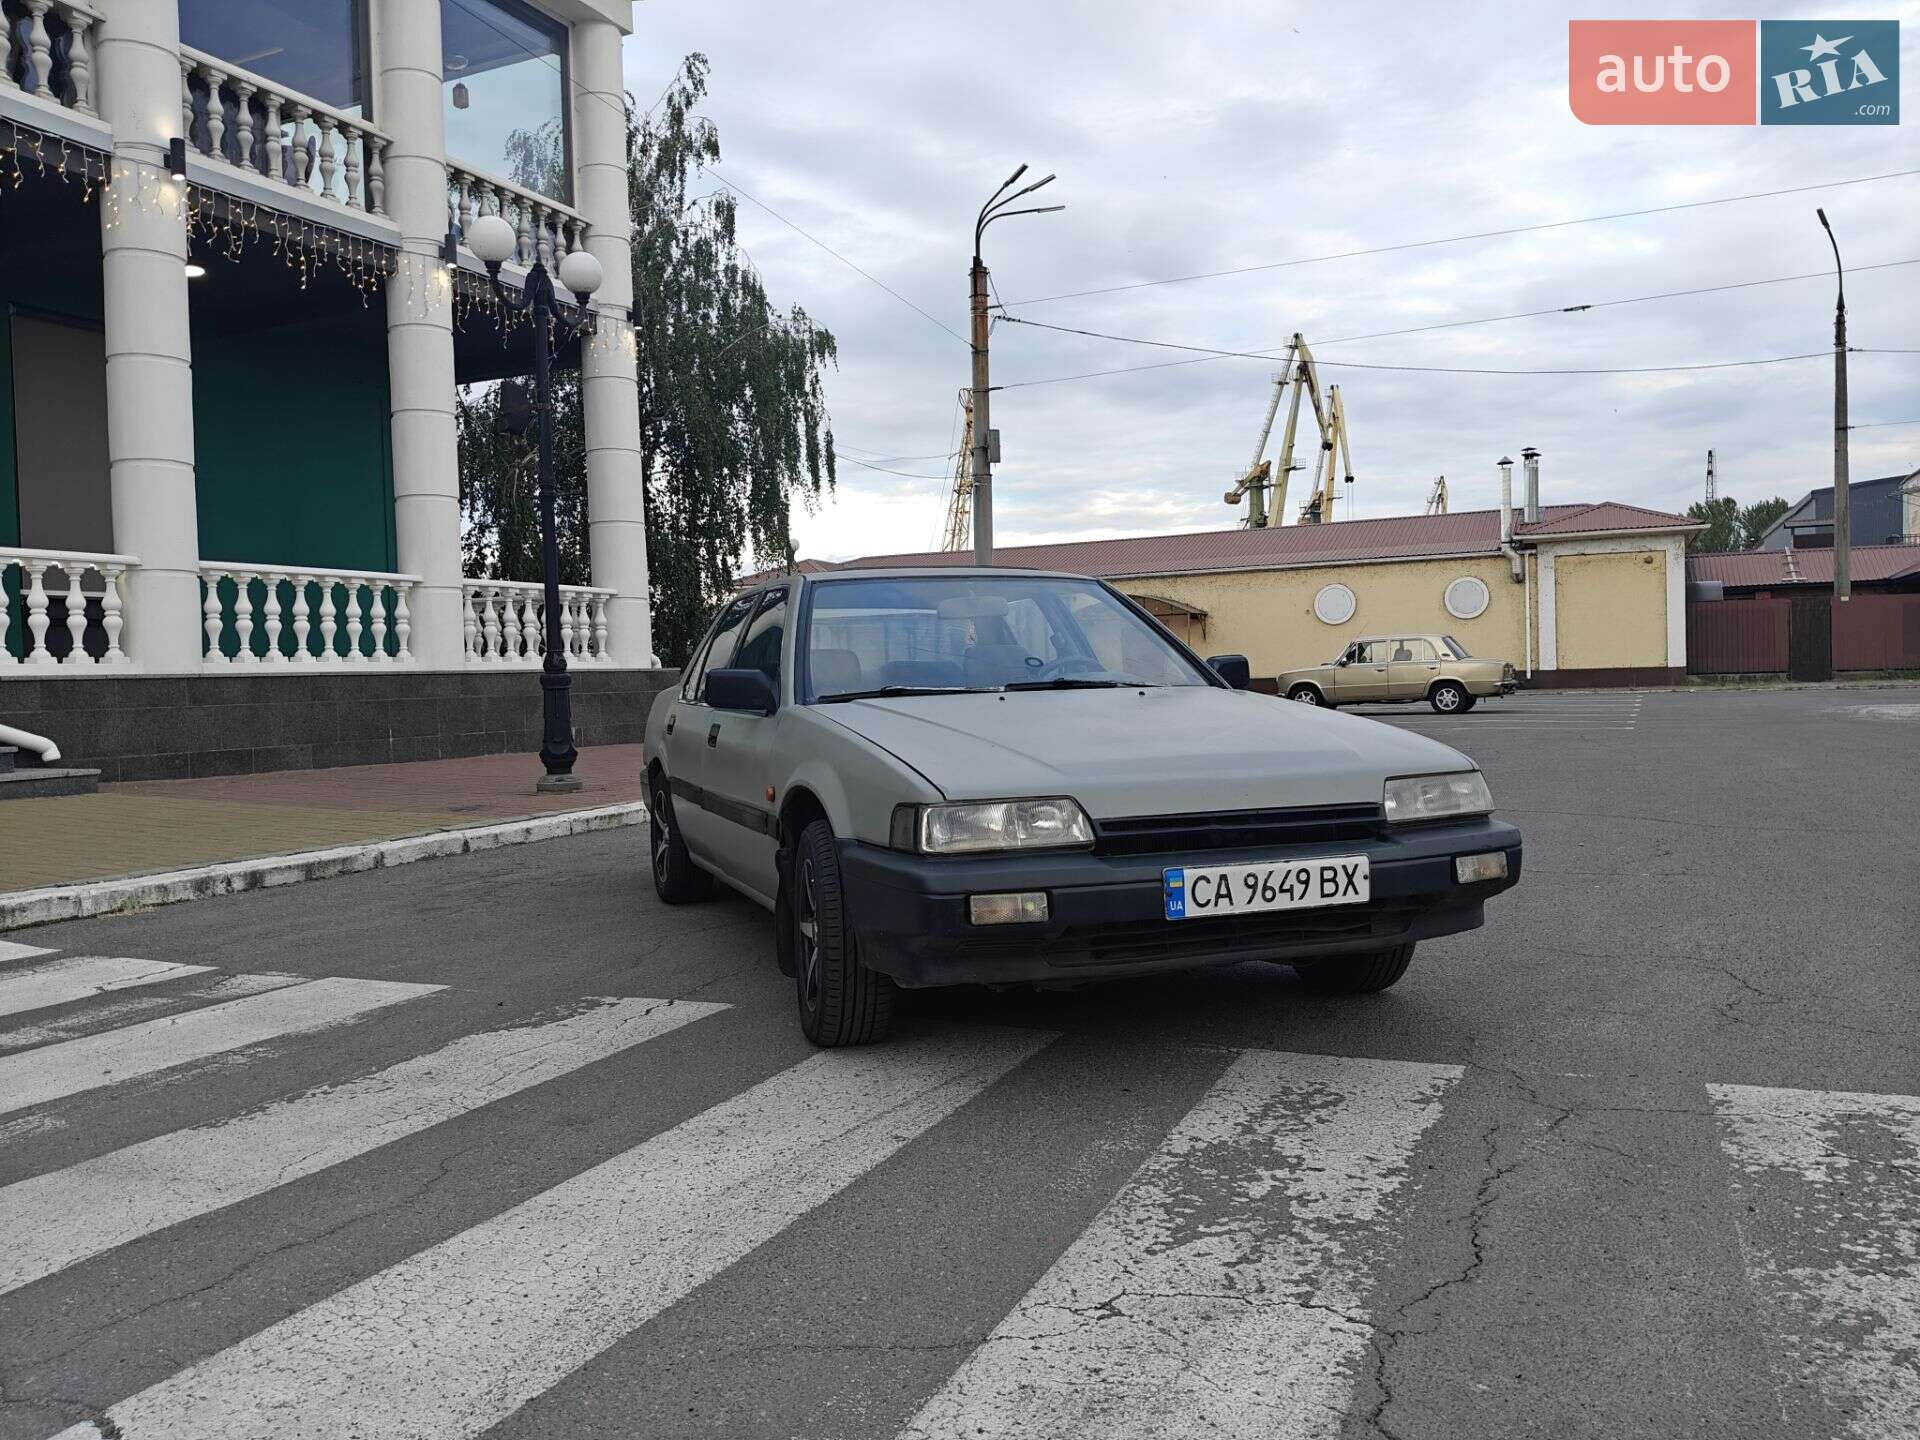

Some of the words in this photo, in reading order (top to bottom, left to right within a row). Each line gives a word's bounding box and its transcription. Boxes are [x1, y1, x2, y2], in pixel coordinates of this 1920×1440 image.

[1191, 873, 1234, 908] CA
[1243, 867, 1311, 905] 9649
[1320, 863, 1360, 899] BX
[1169, 901, 1184, 912] UA
